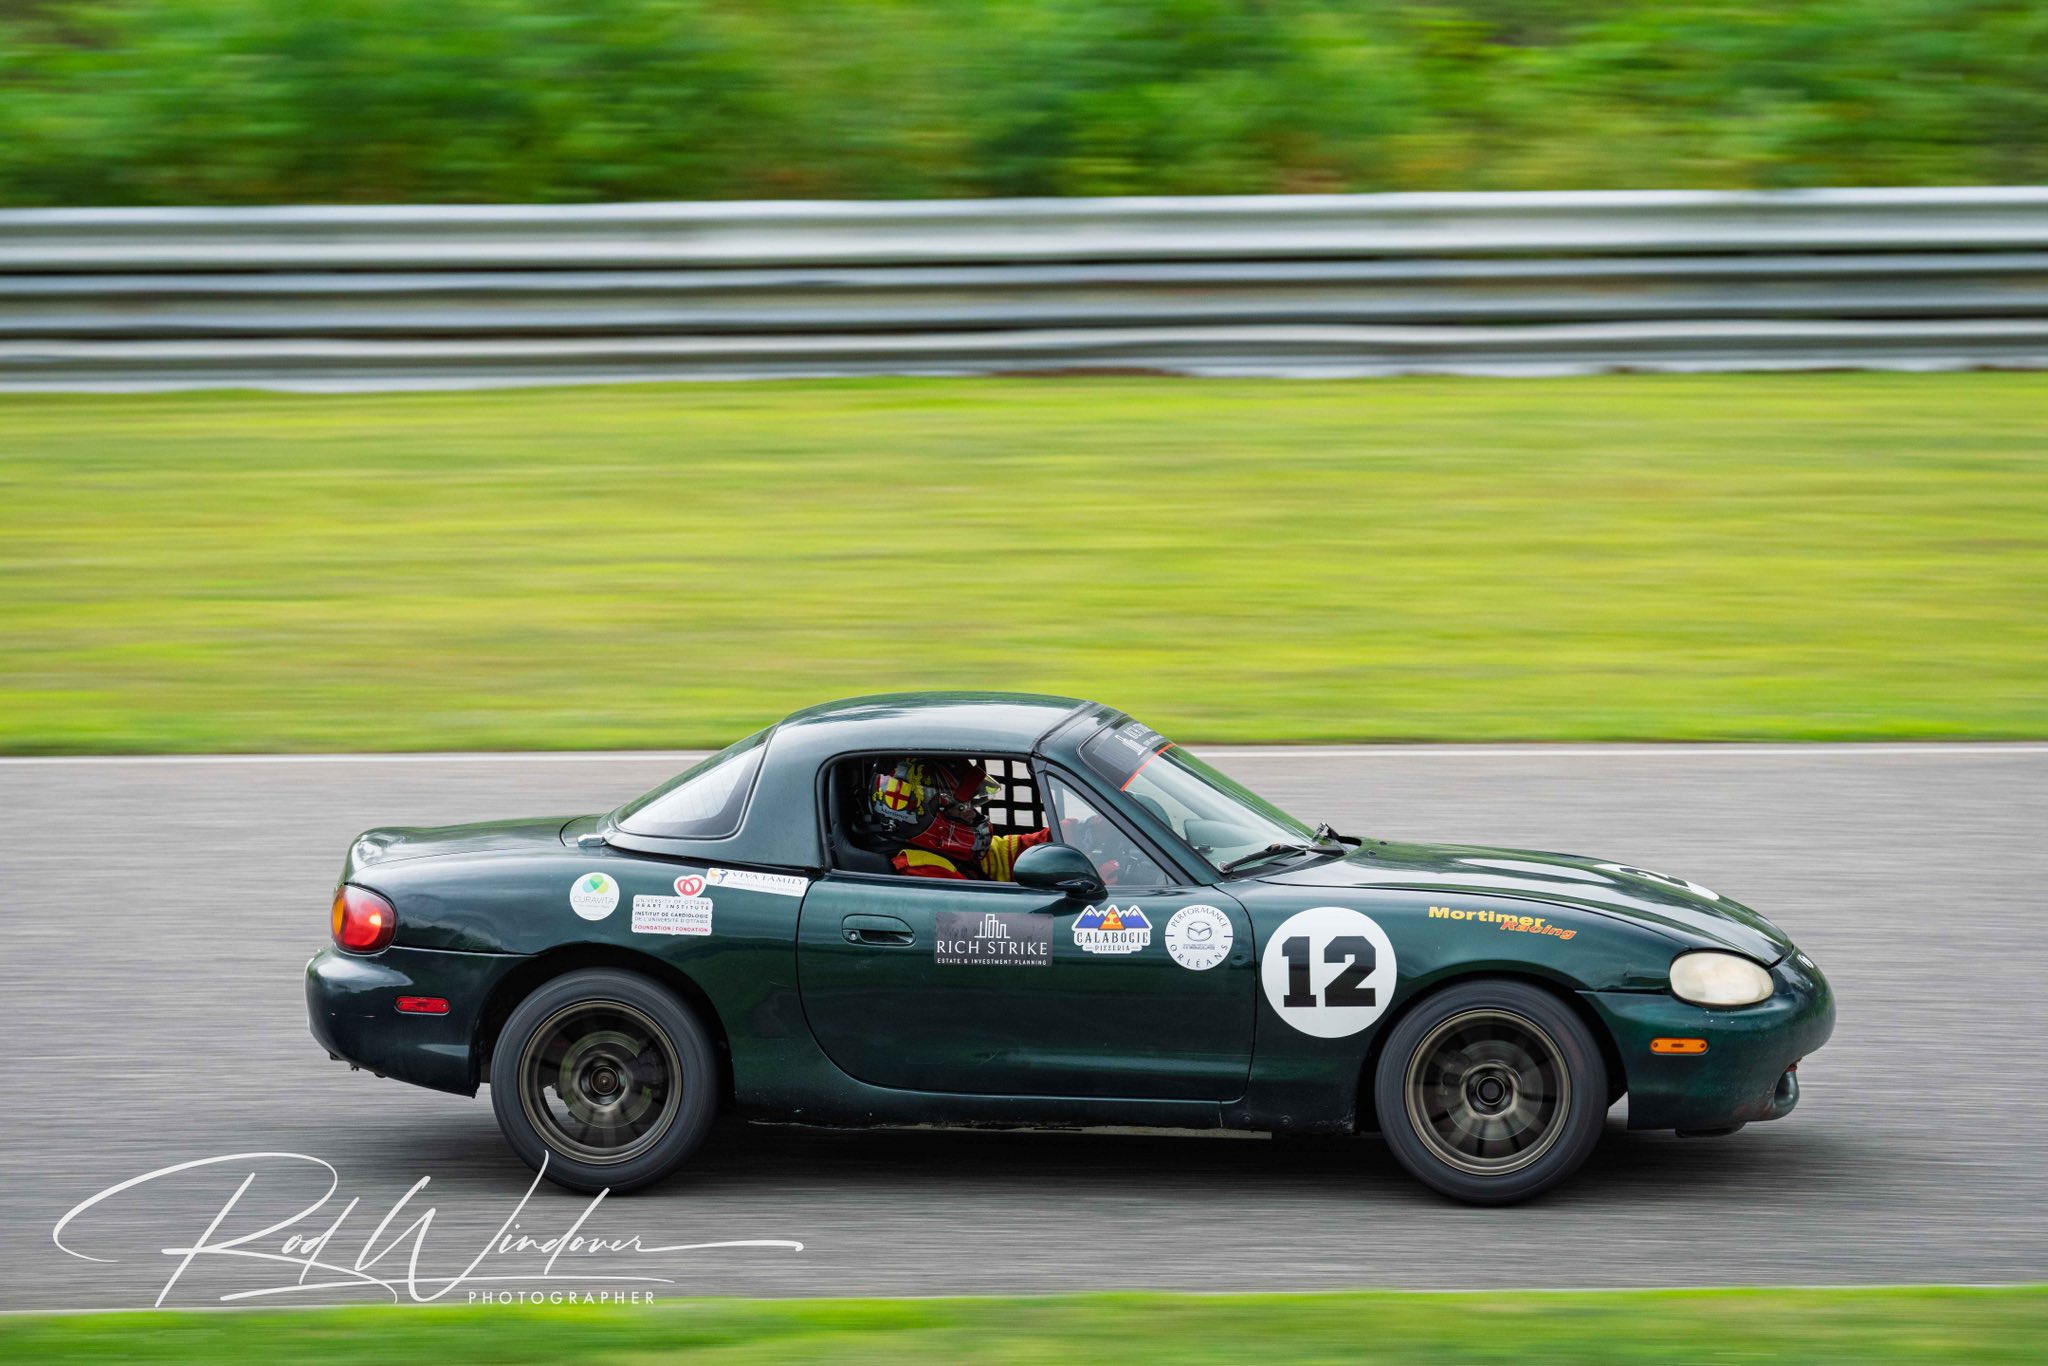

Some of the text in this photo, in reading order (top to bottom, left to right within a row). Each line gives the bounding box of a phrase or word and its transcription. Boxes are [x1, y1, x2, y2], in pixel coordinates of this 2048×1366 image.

[732, 871, 805, 885] VIVA FAMILY
[1170, 907, 1229, 928] PERFORMANCE
[1428, 906, 1546, 927] Mortimer
[1076, 931, 1149, 944] CALABOGIE
[1499, 920, 1577, 940] Racing
[936, 940, 1048, 955] RICH STRIKE
[1170, 944, 1229, 968] ORLÉANS
[1281, 935, 1377, 1008] 12
